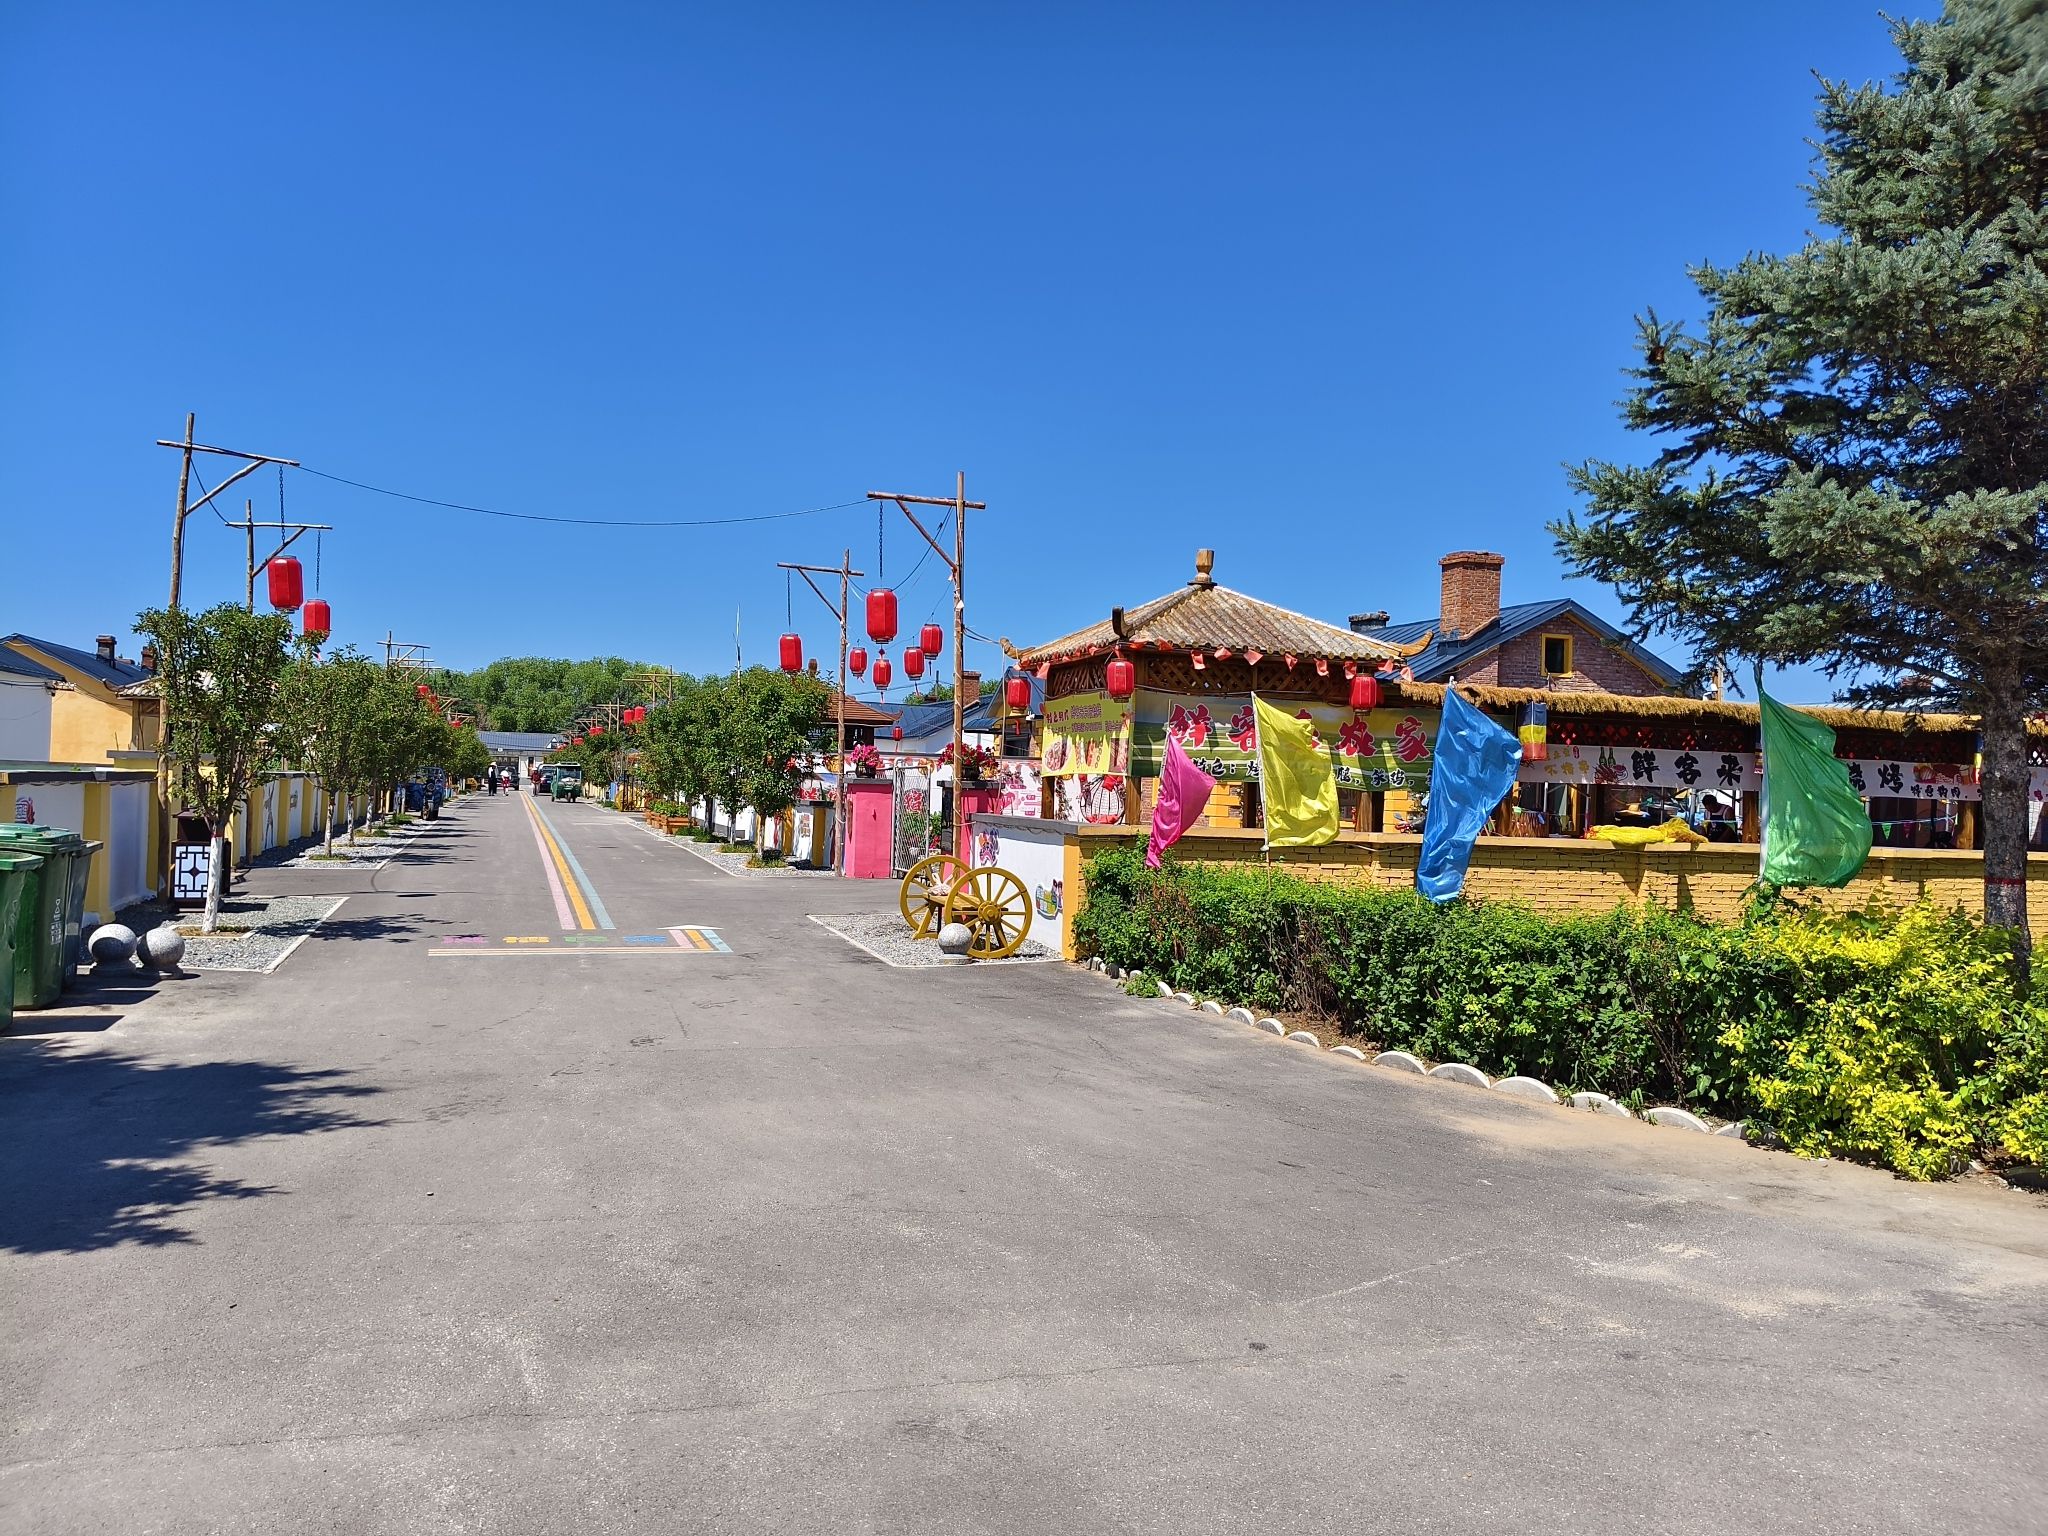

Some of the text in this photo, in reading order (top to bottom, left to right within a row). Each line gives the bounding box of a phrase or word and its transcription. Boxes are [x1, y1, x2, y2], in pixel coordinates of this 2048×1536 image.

[1168, 702, 1431, 763] 鲜客农家
[1630, 749, 1743, 787] 鲜客来
